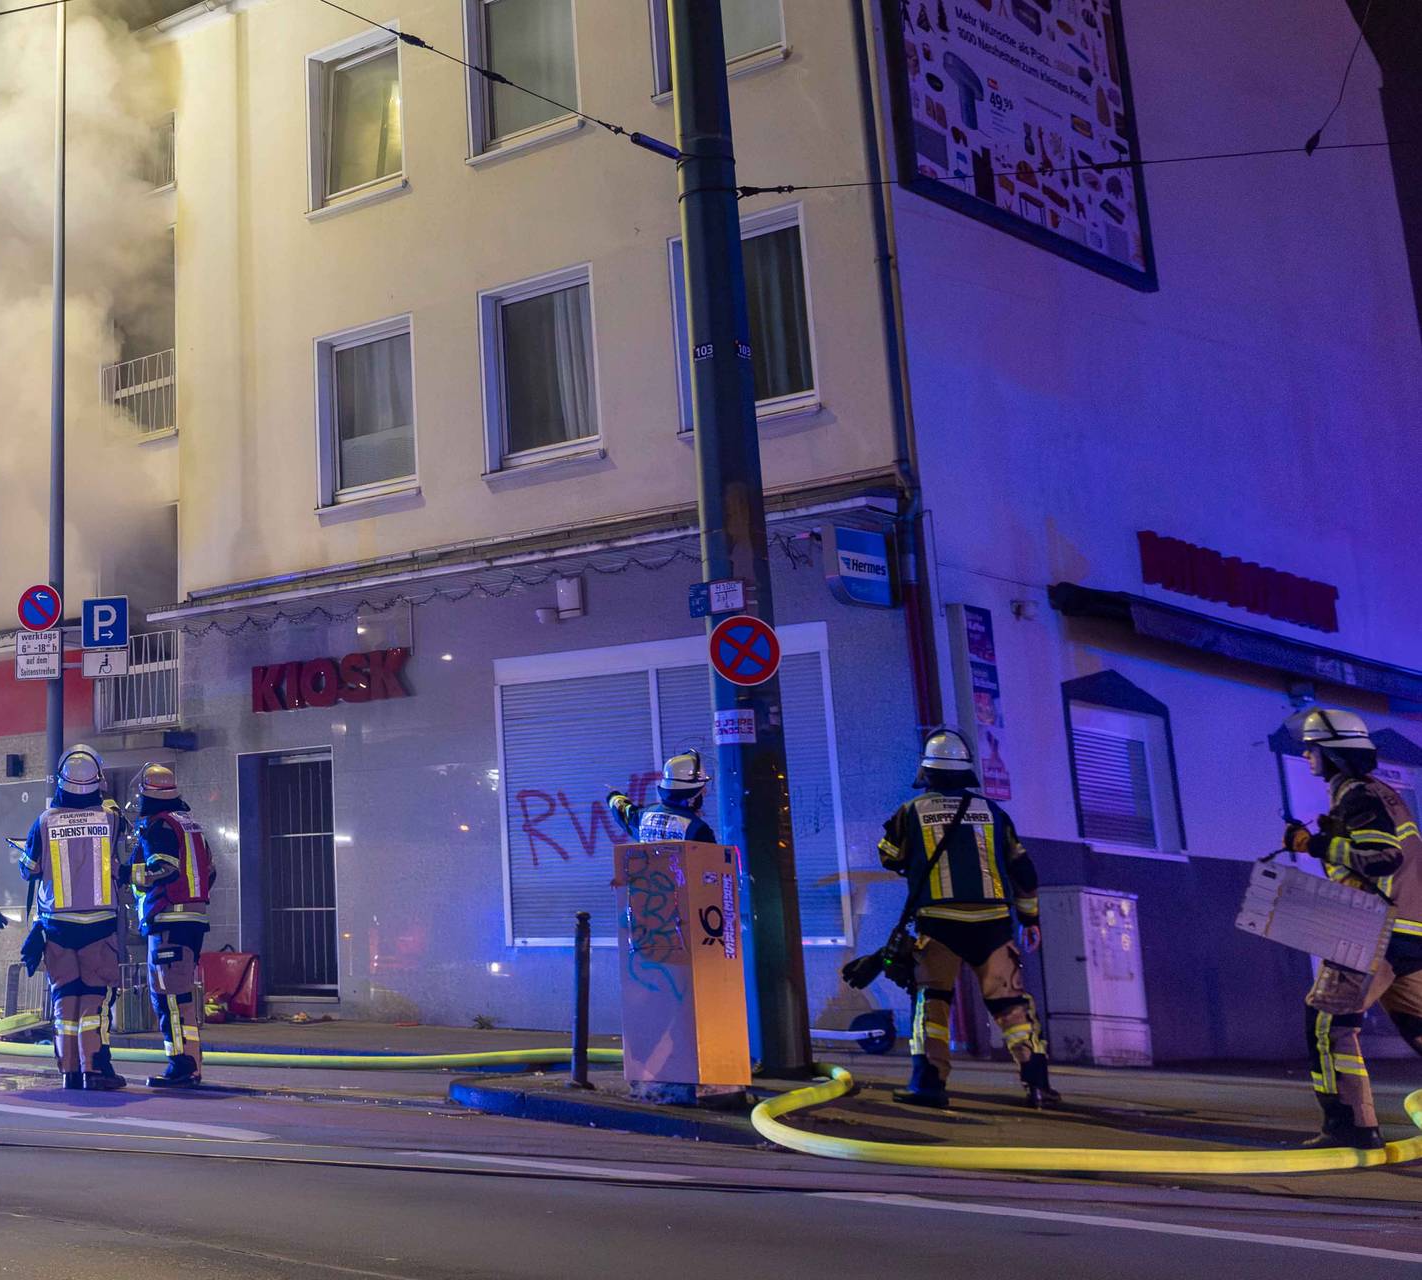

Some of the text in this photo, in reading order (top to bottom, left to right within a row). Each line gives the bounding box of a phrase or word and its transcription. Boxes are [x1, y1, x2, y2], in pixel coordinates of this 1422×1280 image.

[695, 344, 714, 357] 103
[738, 344, 752, 357] 103
[852, 559, 887, 576] Hermes
[93, 604, 118, 642] P
[21, 632, 58, 642] werktags
[26, 656, 48, 665] auf dem
[252, 647, 411, 713] KIOSK
[51, 826, 108, 838] B-DIENST NORD
